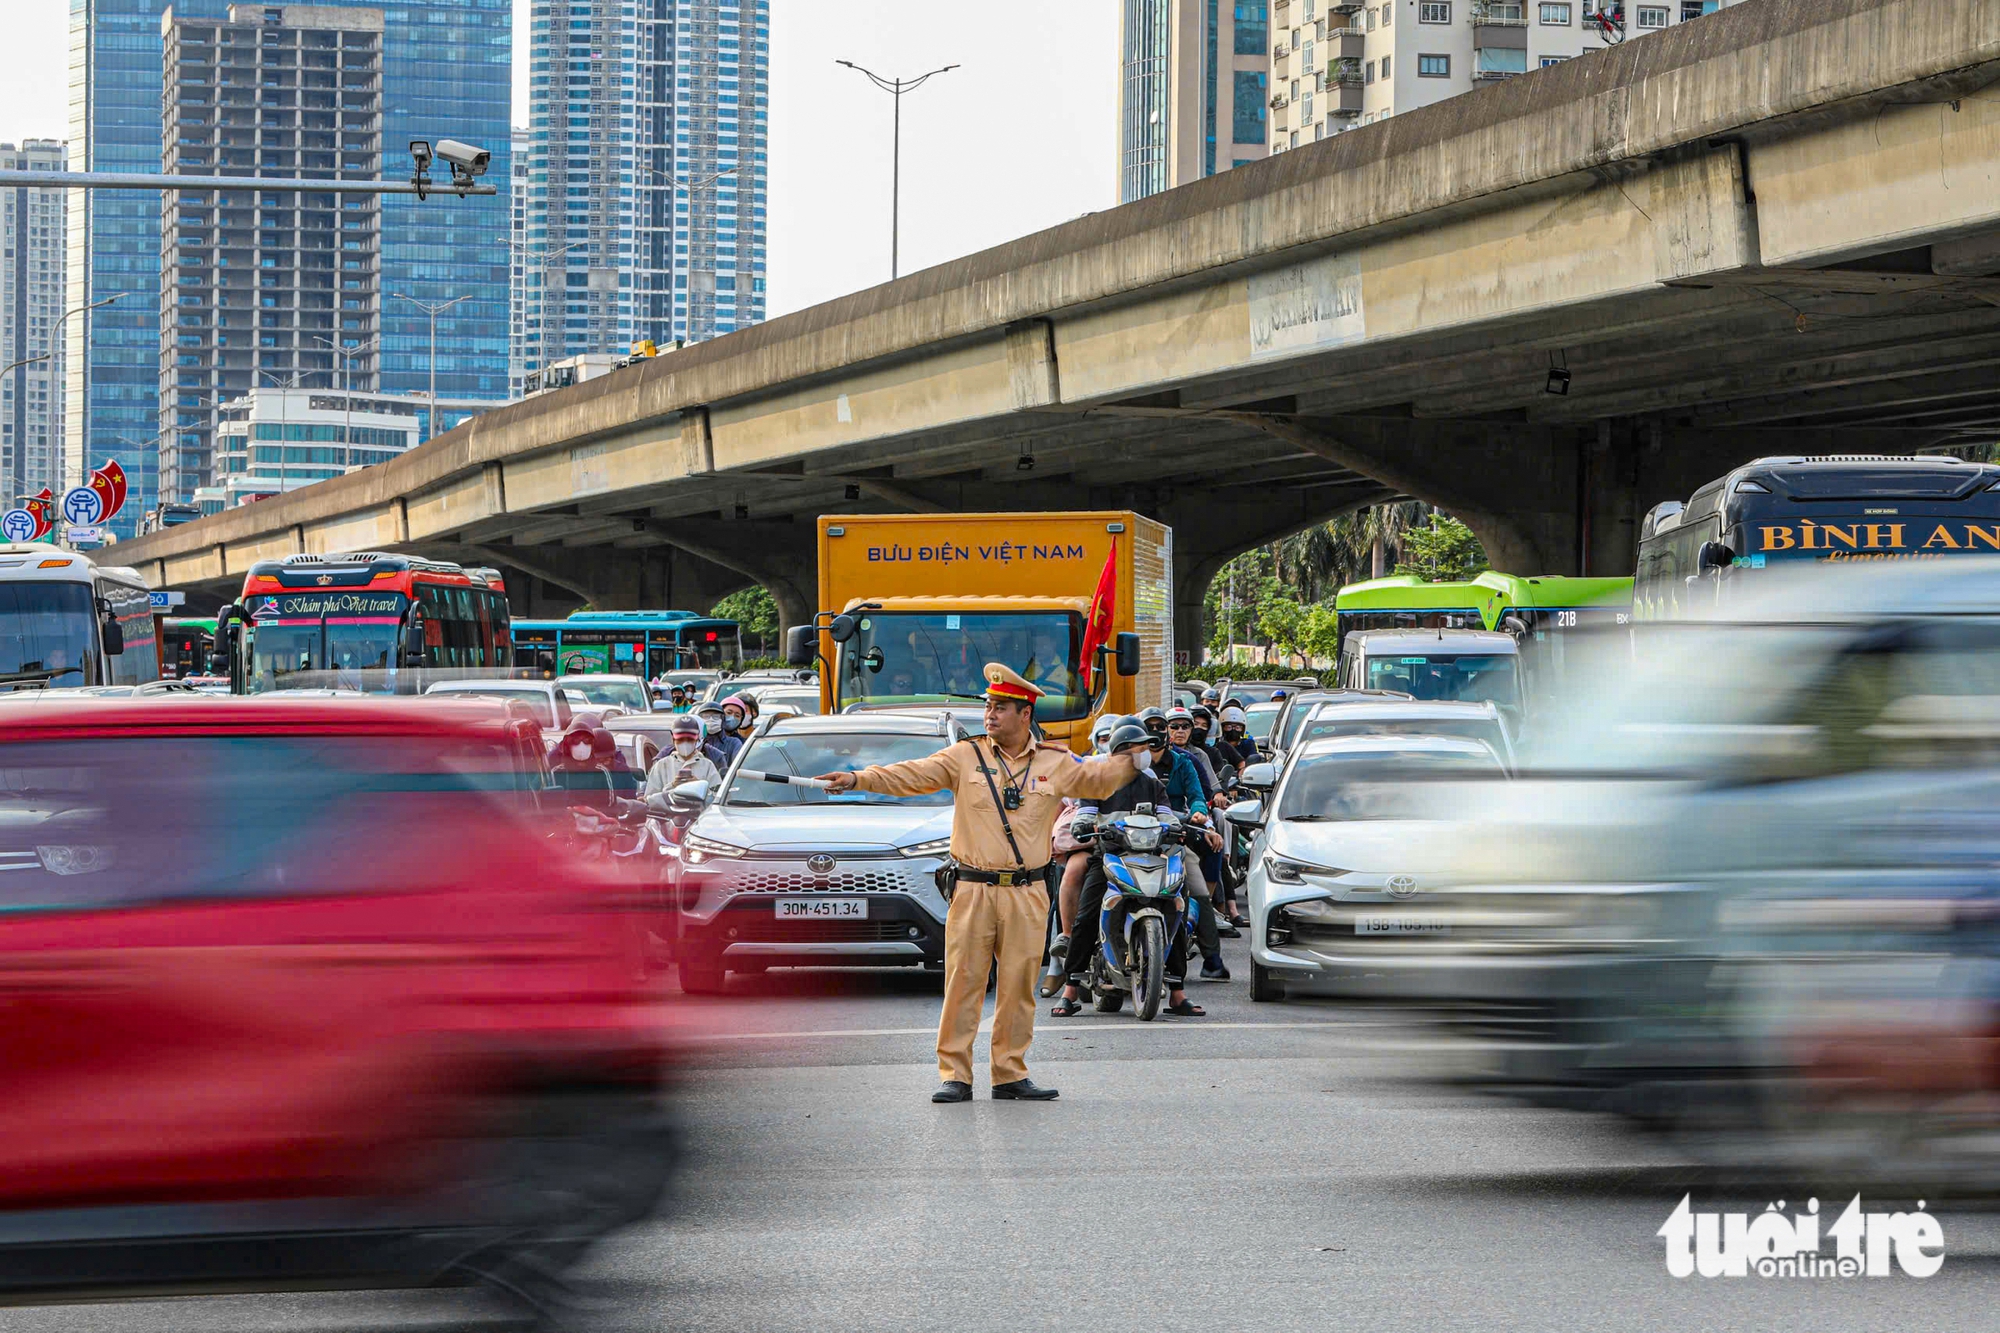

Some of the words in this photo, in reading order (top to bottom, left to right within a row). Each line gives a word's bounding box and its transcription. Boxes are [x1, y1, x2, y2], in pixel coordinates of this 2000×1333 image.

[1758, 519, 1907, 550] BÌNH
[1922, 524, 2000, 549] AN
[868, 543, 912, 561] BƯU
[918, 542, 969, 565] ĐIỆN
[978, 541, 1027, 564] VIỆT
[1033, 545, 1083, 559] NAM
[284, 596, 320, 613] Khám
[320, 595, 340, 618] phá
[340, 595, 367, 614] Việt
[369, 596, 399, 611] travel
[1558, 611, 1576, 627] 21B
